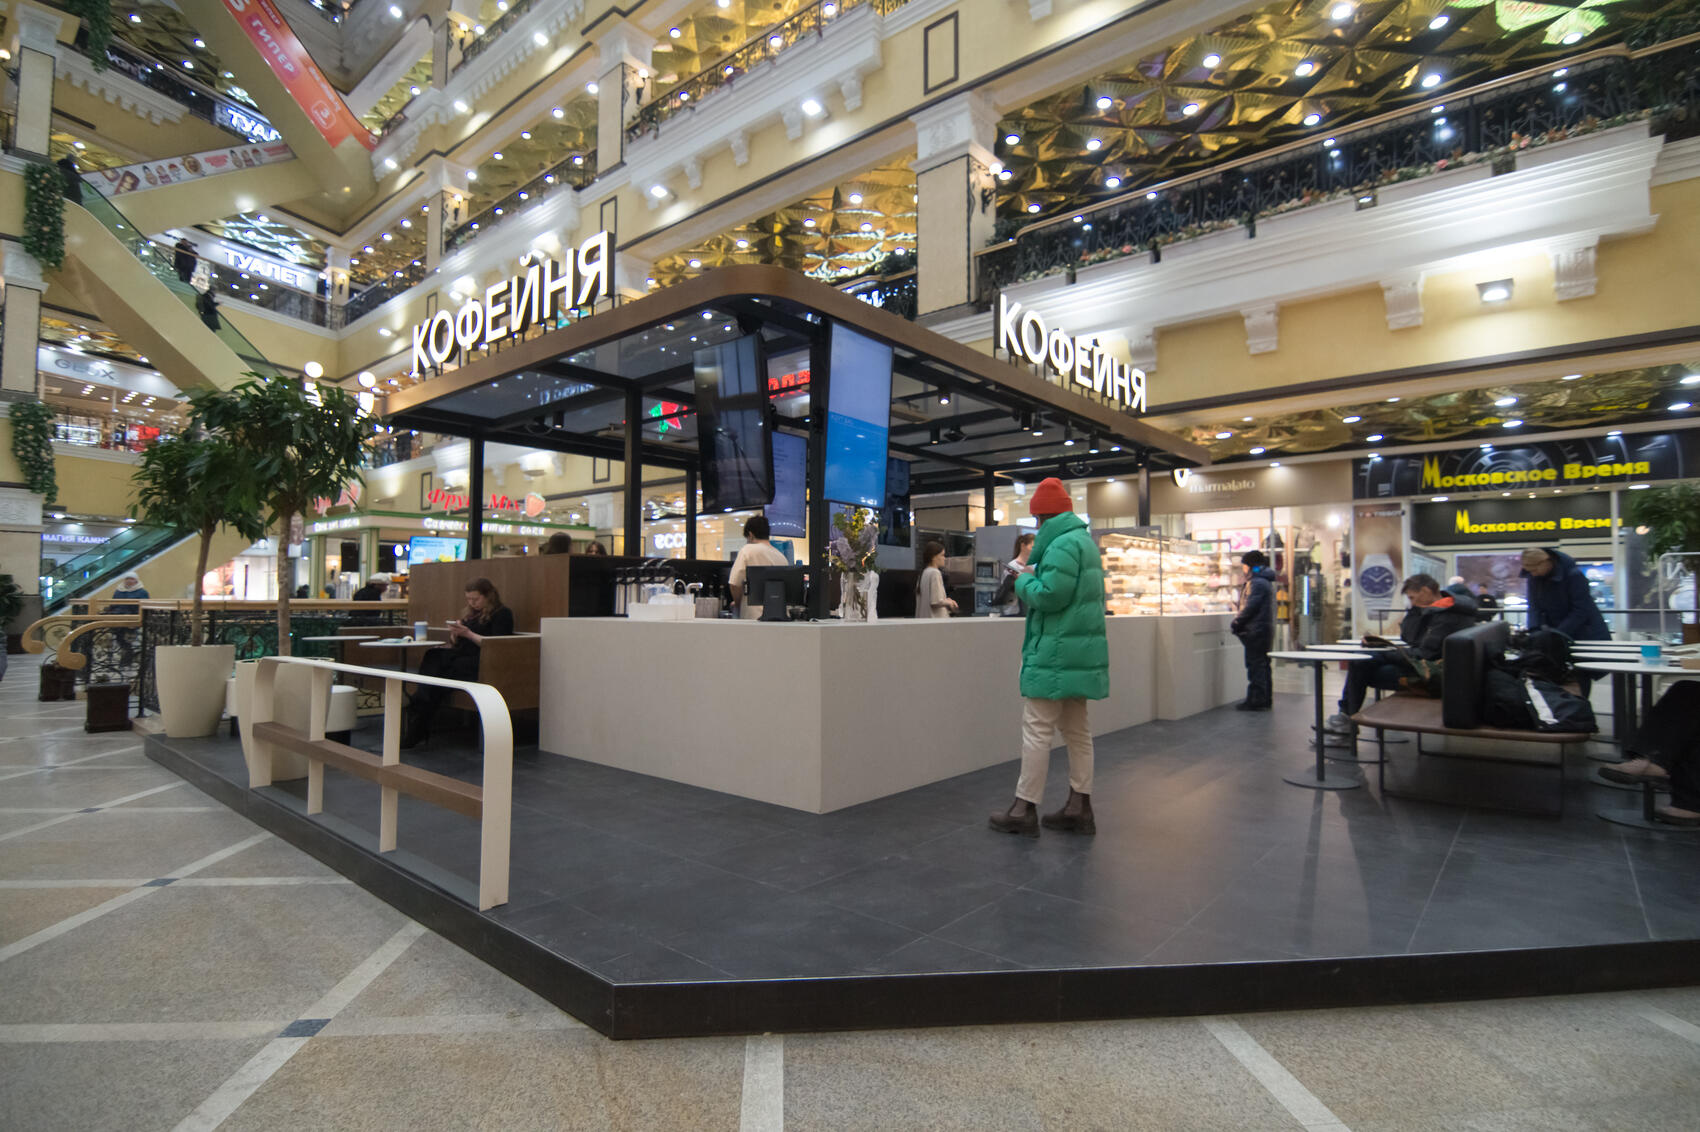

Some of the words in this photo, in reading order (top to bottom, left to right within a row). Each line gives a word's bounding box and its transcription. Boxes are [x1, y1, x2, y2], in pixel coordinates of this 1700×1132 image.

[251, 19, 295, 73] ГИПЕР
[226, 107, 282, 142] ТУАЛ
[225, 248, 306, 288] ТУАЛЕТ
[412, 230, 614, 375] КОФЕЙНЯ
[1000, 293, 1147, 413] КОФЕЙНЯ
[1422, 455, 1558, 489] Московское
[1564, 461, 1650, 480] Время
[428, 488, 470, 512] Фру
[1455, 509, 1557, 534] Московское
